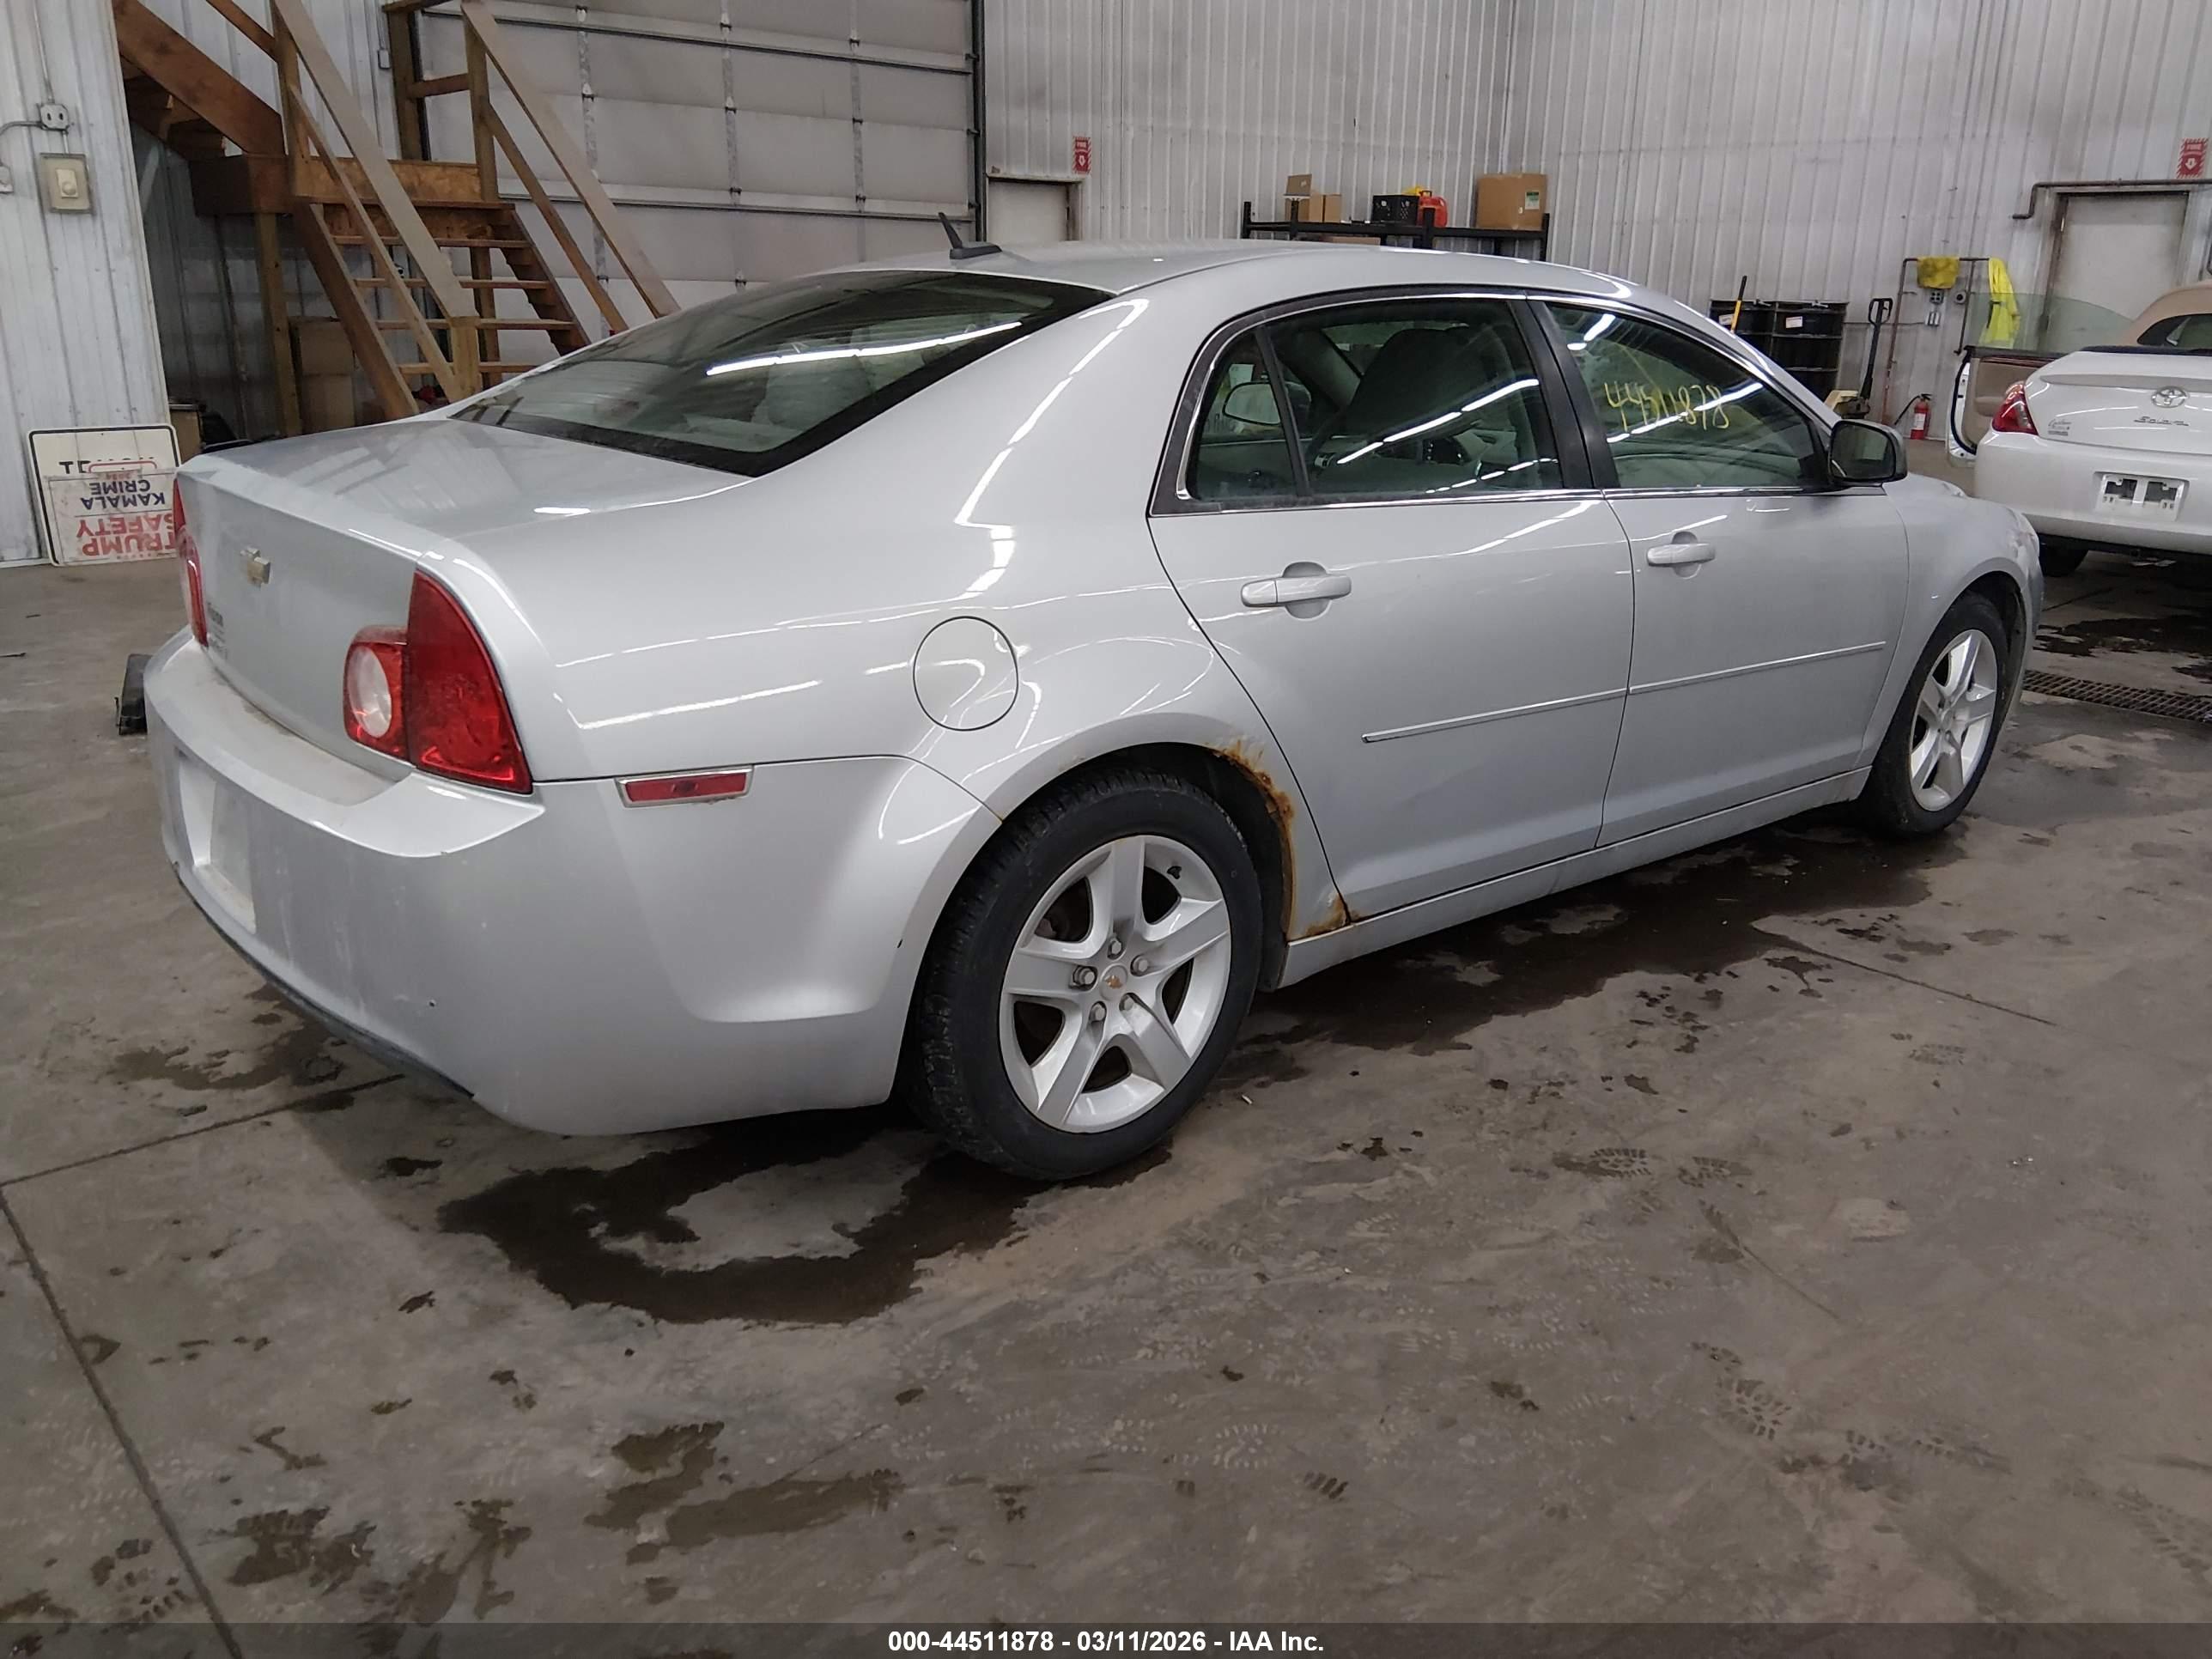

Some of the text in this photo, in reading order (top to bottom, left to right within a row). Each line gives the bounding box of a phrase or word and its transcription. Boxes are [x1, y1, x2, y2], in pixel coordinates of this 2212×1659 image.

[89, 479, 150, 495] CRIME
[81, 492, 165, 510] KAMALA
[76, 514, 173, 538] SAFETY
[82, 532, 176, 556] TRUMP
